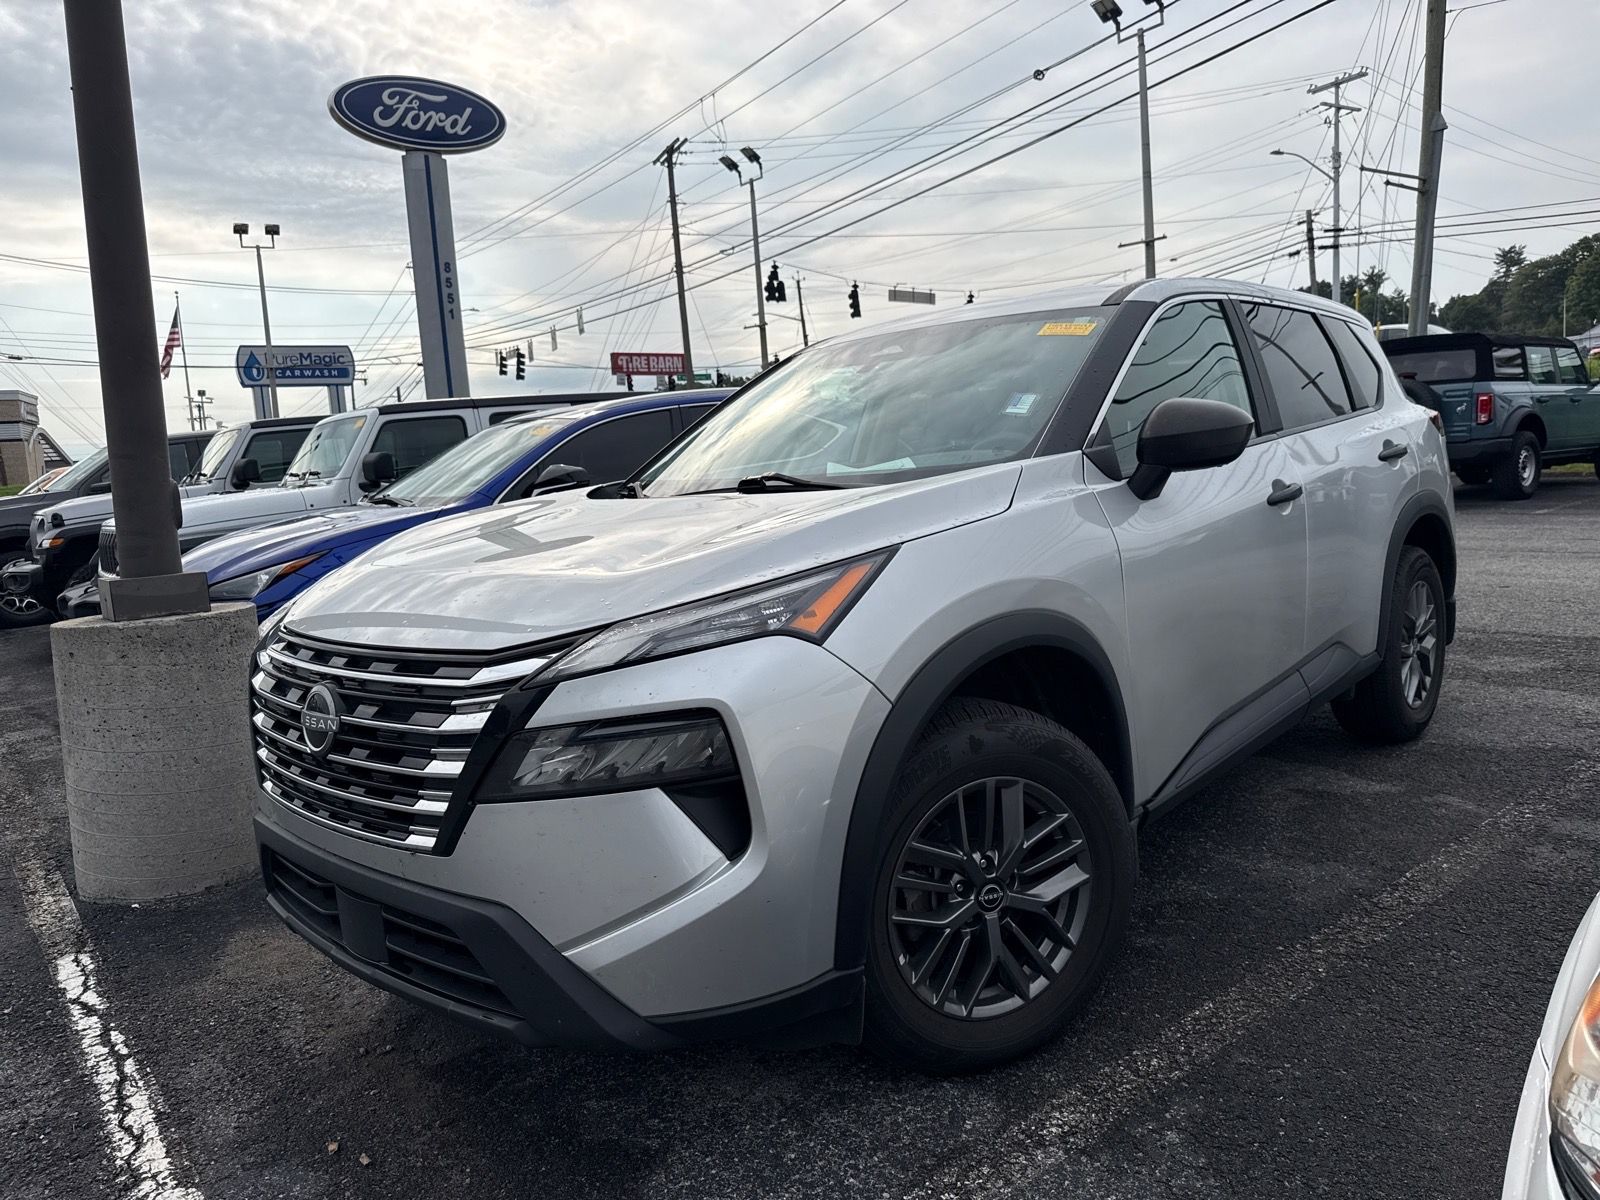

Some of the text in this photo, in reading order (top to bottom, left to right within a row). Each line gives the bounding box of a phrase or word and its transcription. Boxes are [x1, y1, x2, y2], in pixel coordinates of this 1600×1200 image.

[373, 87, 472, 136] Ford
[444, 261, 455, 320] 8551
[618, 355, 683, 372] TIRE BARN
[276, 369, 338, 377] CARWASH
[305, 716, 337, 730] SSAN
